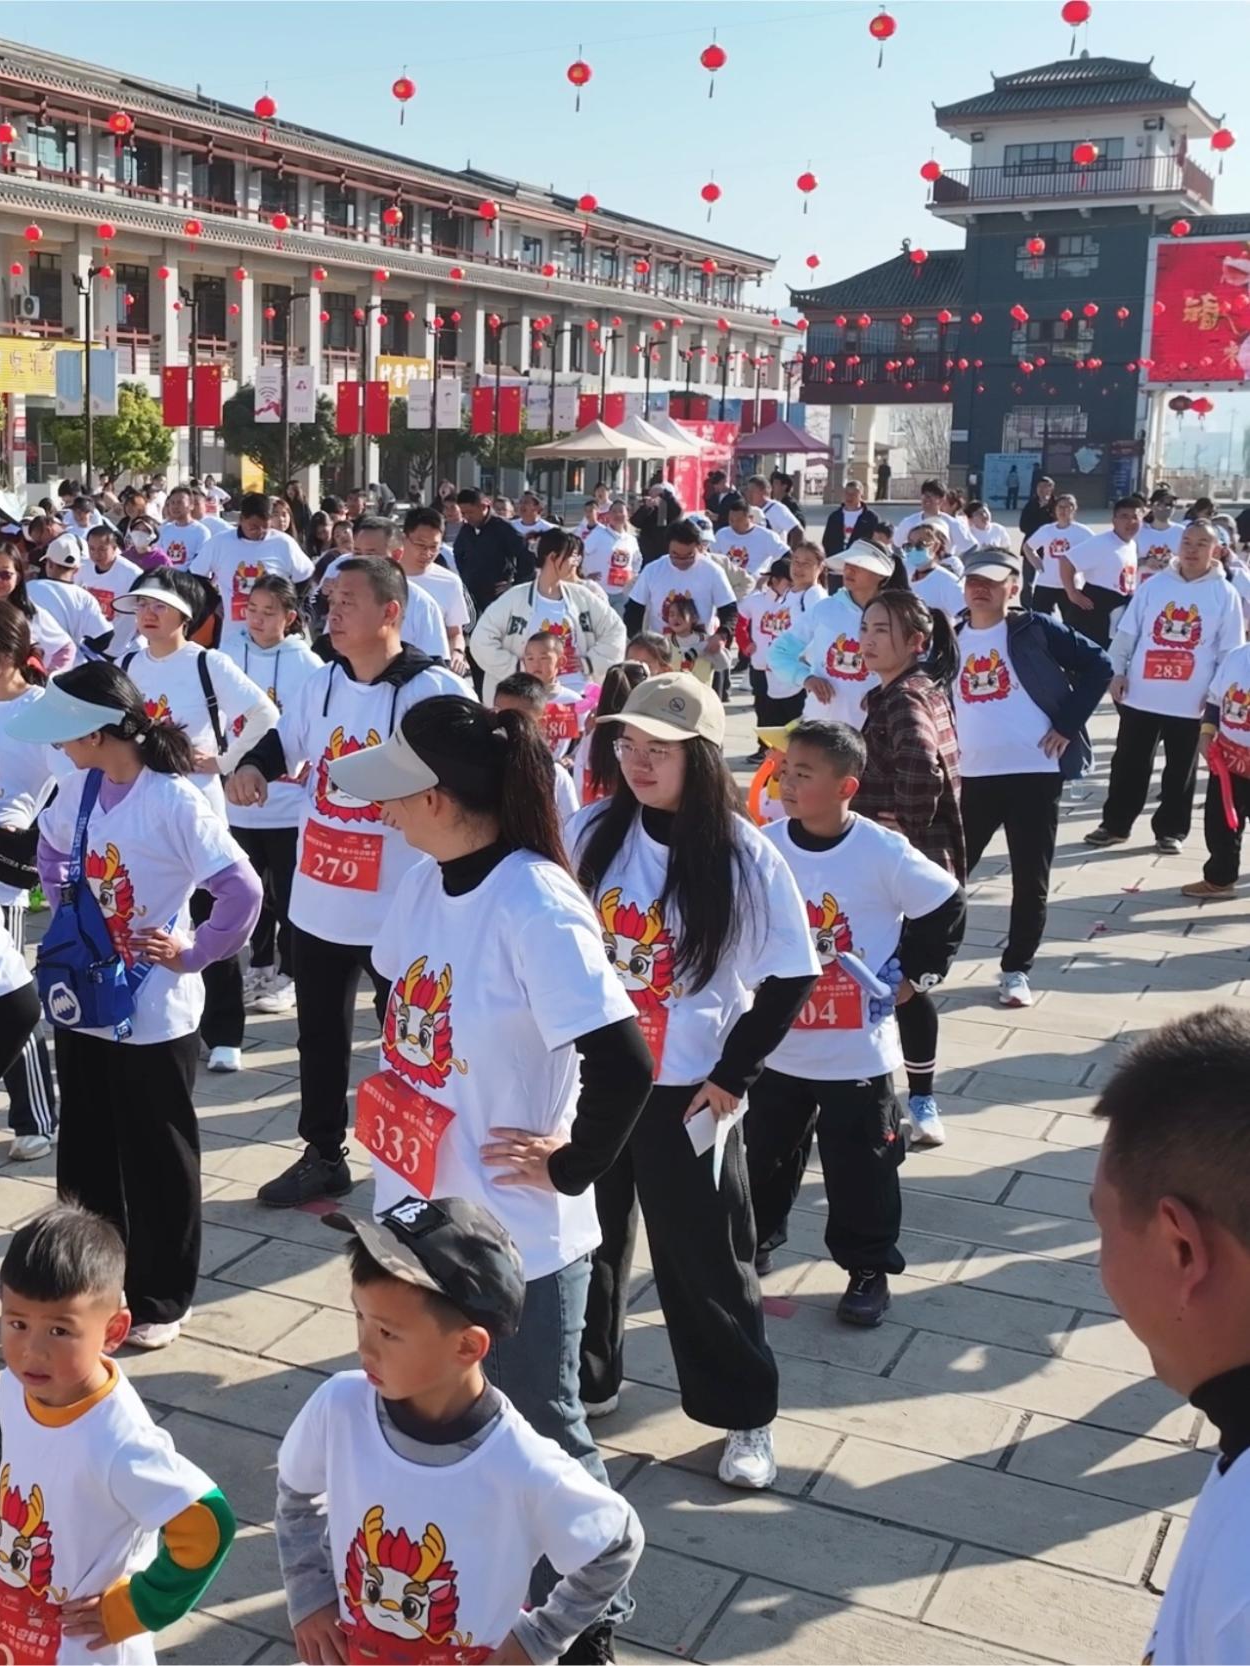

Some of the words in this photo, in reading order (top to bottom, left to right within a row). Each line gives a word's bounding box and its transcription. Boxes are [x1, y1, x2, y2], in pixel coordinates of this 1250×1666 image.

[1153, 664, 1183, 678] 283
[312, 852, 359, 884] 279
[371, 1114, 421, 1176] 333
